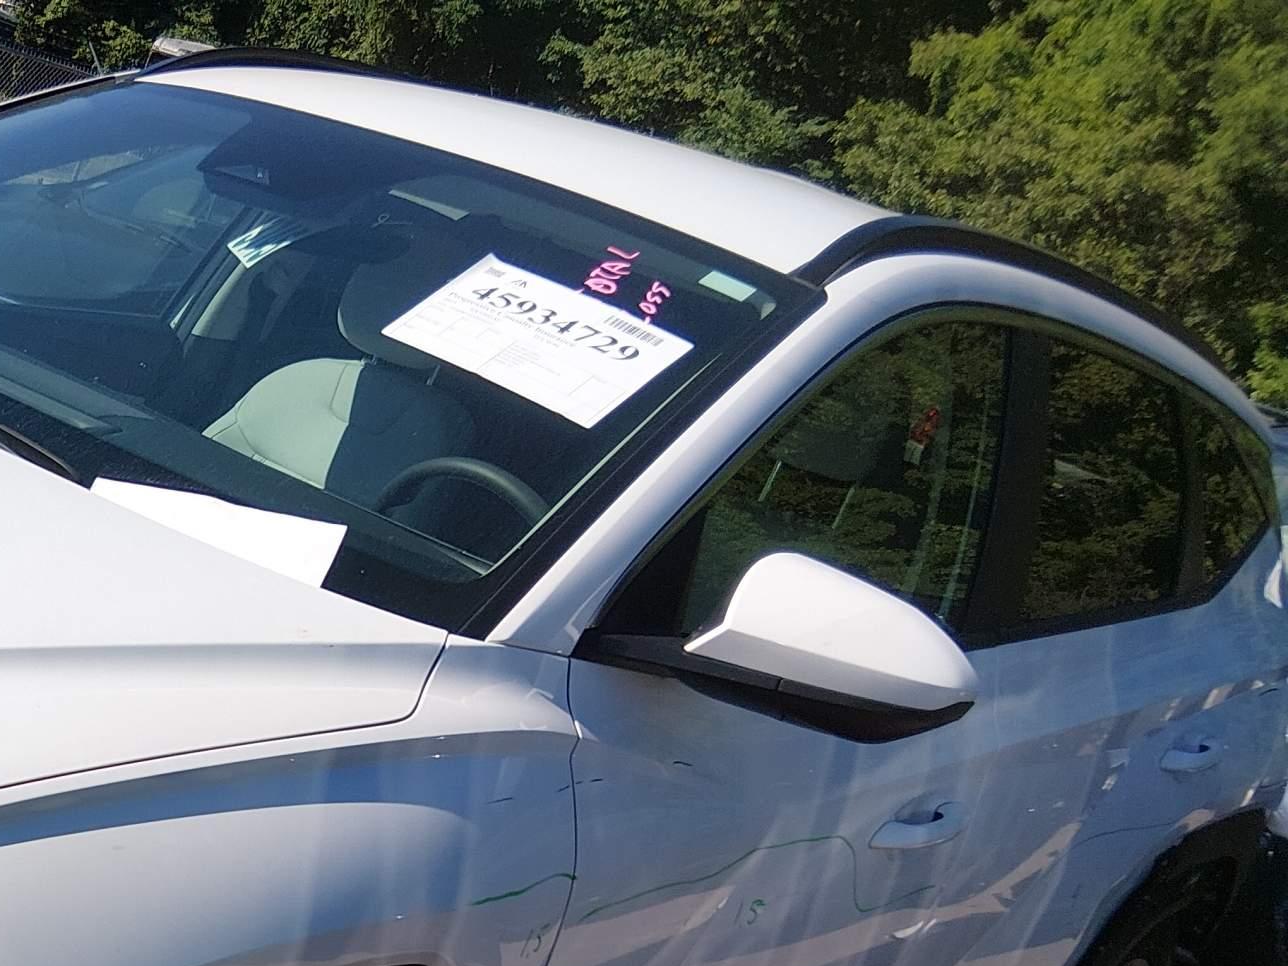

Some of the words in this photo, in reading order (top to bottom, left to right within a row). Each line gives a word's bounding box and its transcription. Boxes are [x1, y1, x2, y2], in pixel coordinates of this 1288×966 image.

[583, 245, 641, 295] OTAL
[471, 286, 640, 361] 45934729
[638, 281, 671, 325] OSS
